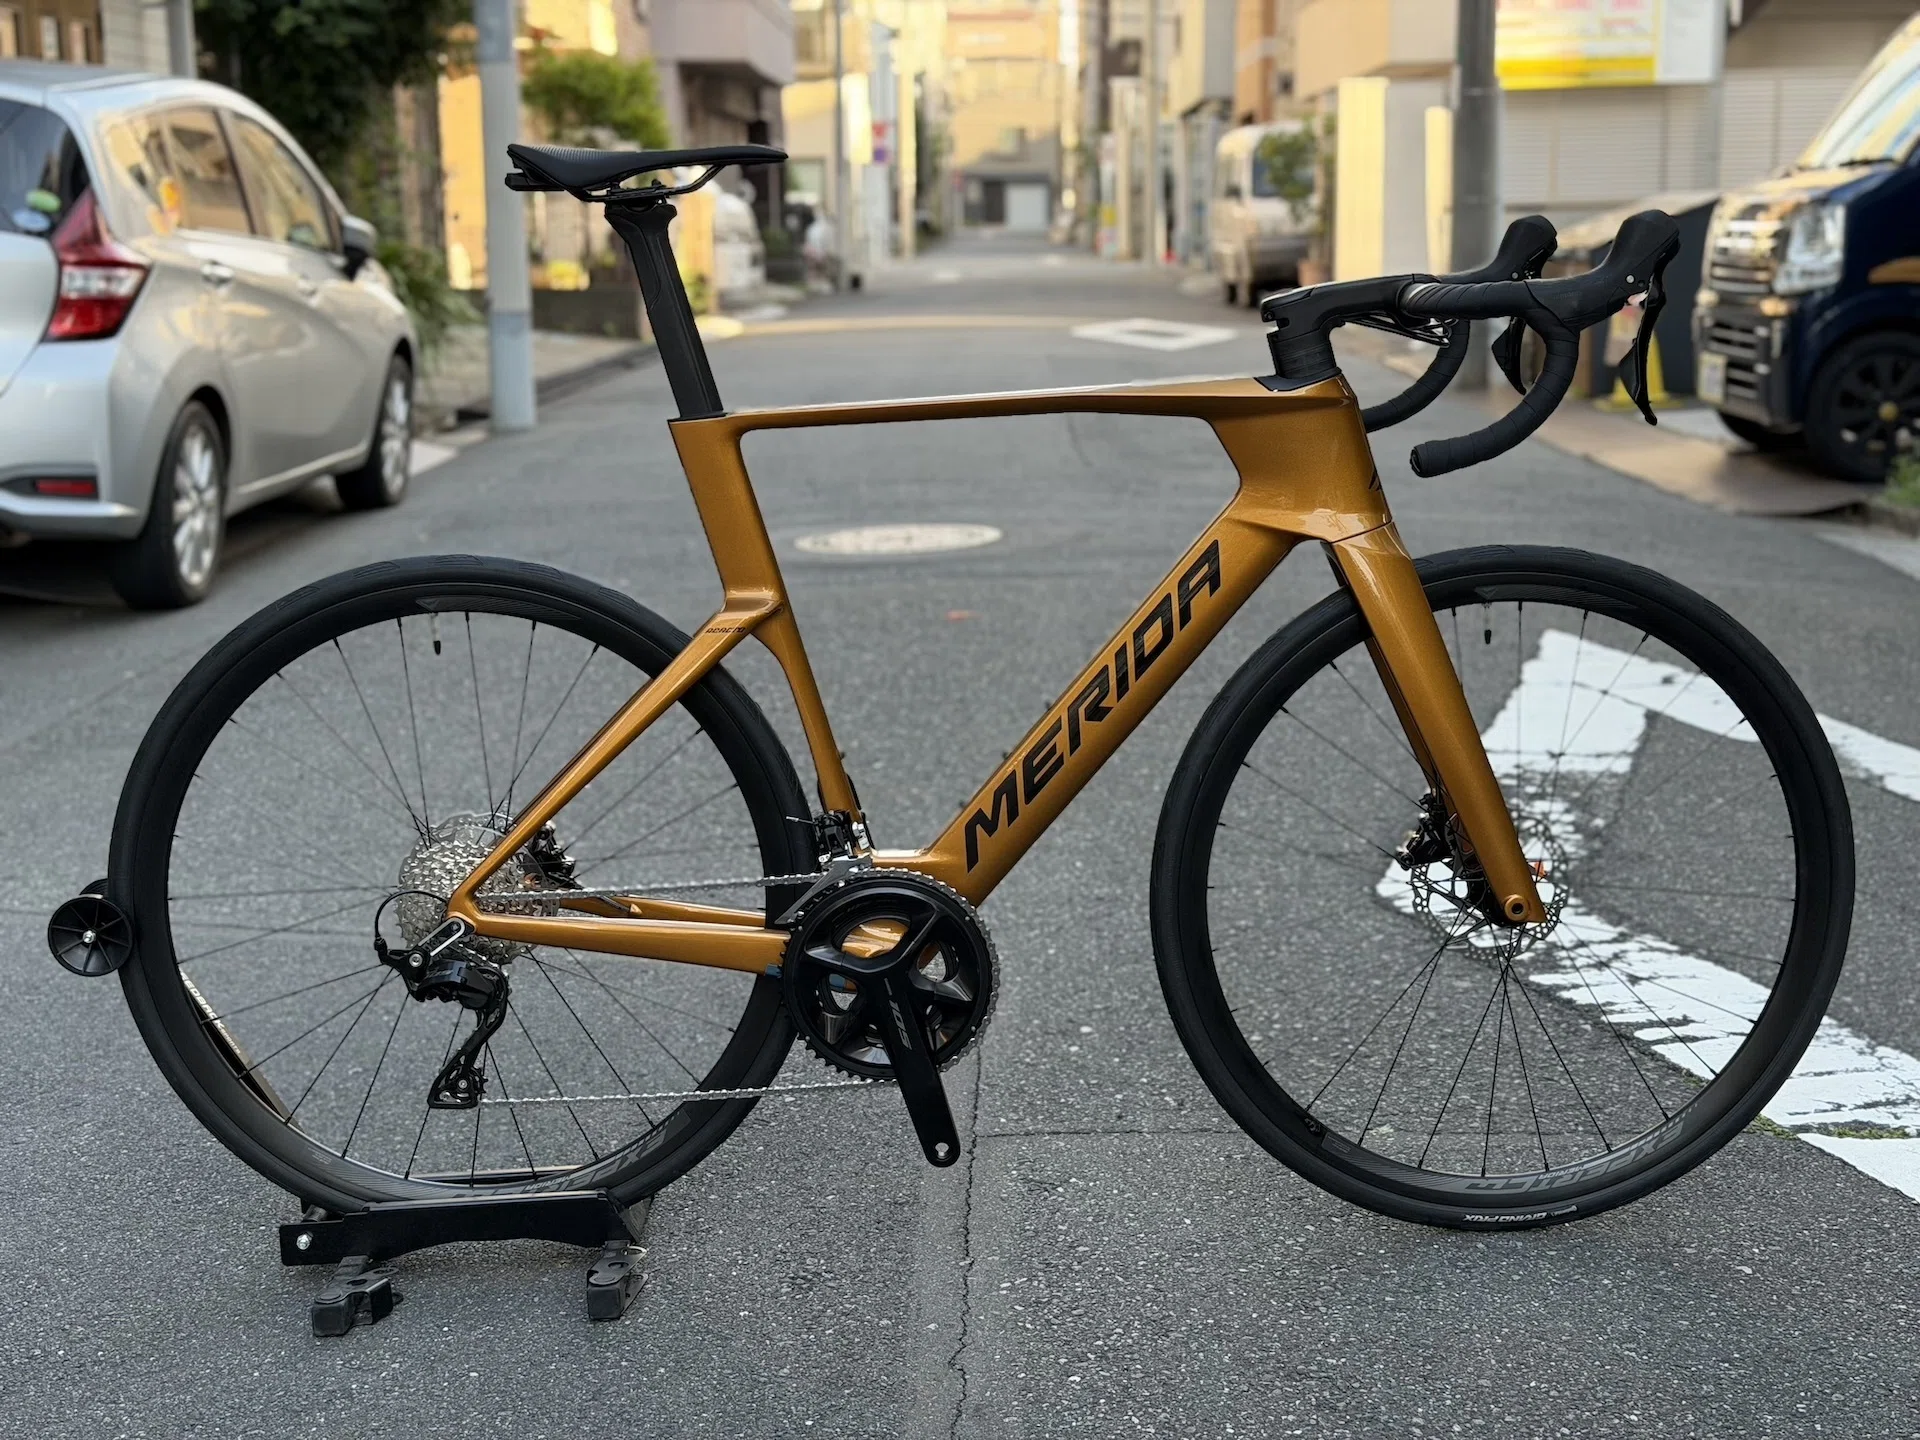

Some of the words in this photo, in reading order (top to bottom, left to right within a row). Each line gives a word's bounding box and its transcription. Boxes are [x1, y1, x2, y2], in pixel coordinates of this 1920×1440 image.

[964, 539, 1221, 873] MERIDA
[179, 965, 225, 1030] EEDBACK
[888, 999, 912, 1051] 105
[525, 1175, 572, 1191] MERIDA
[1528, 1120, 1684, 1193] EXPERT
[1539, 1165, 1585, 1180] MERIDA
